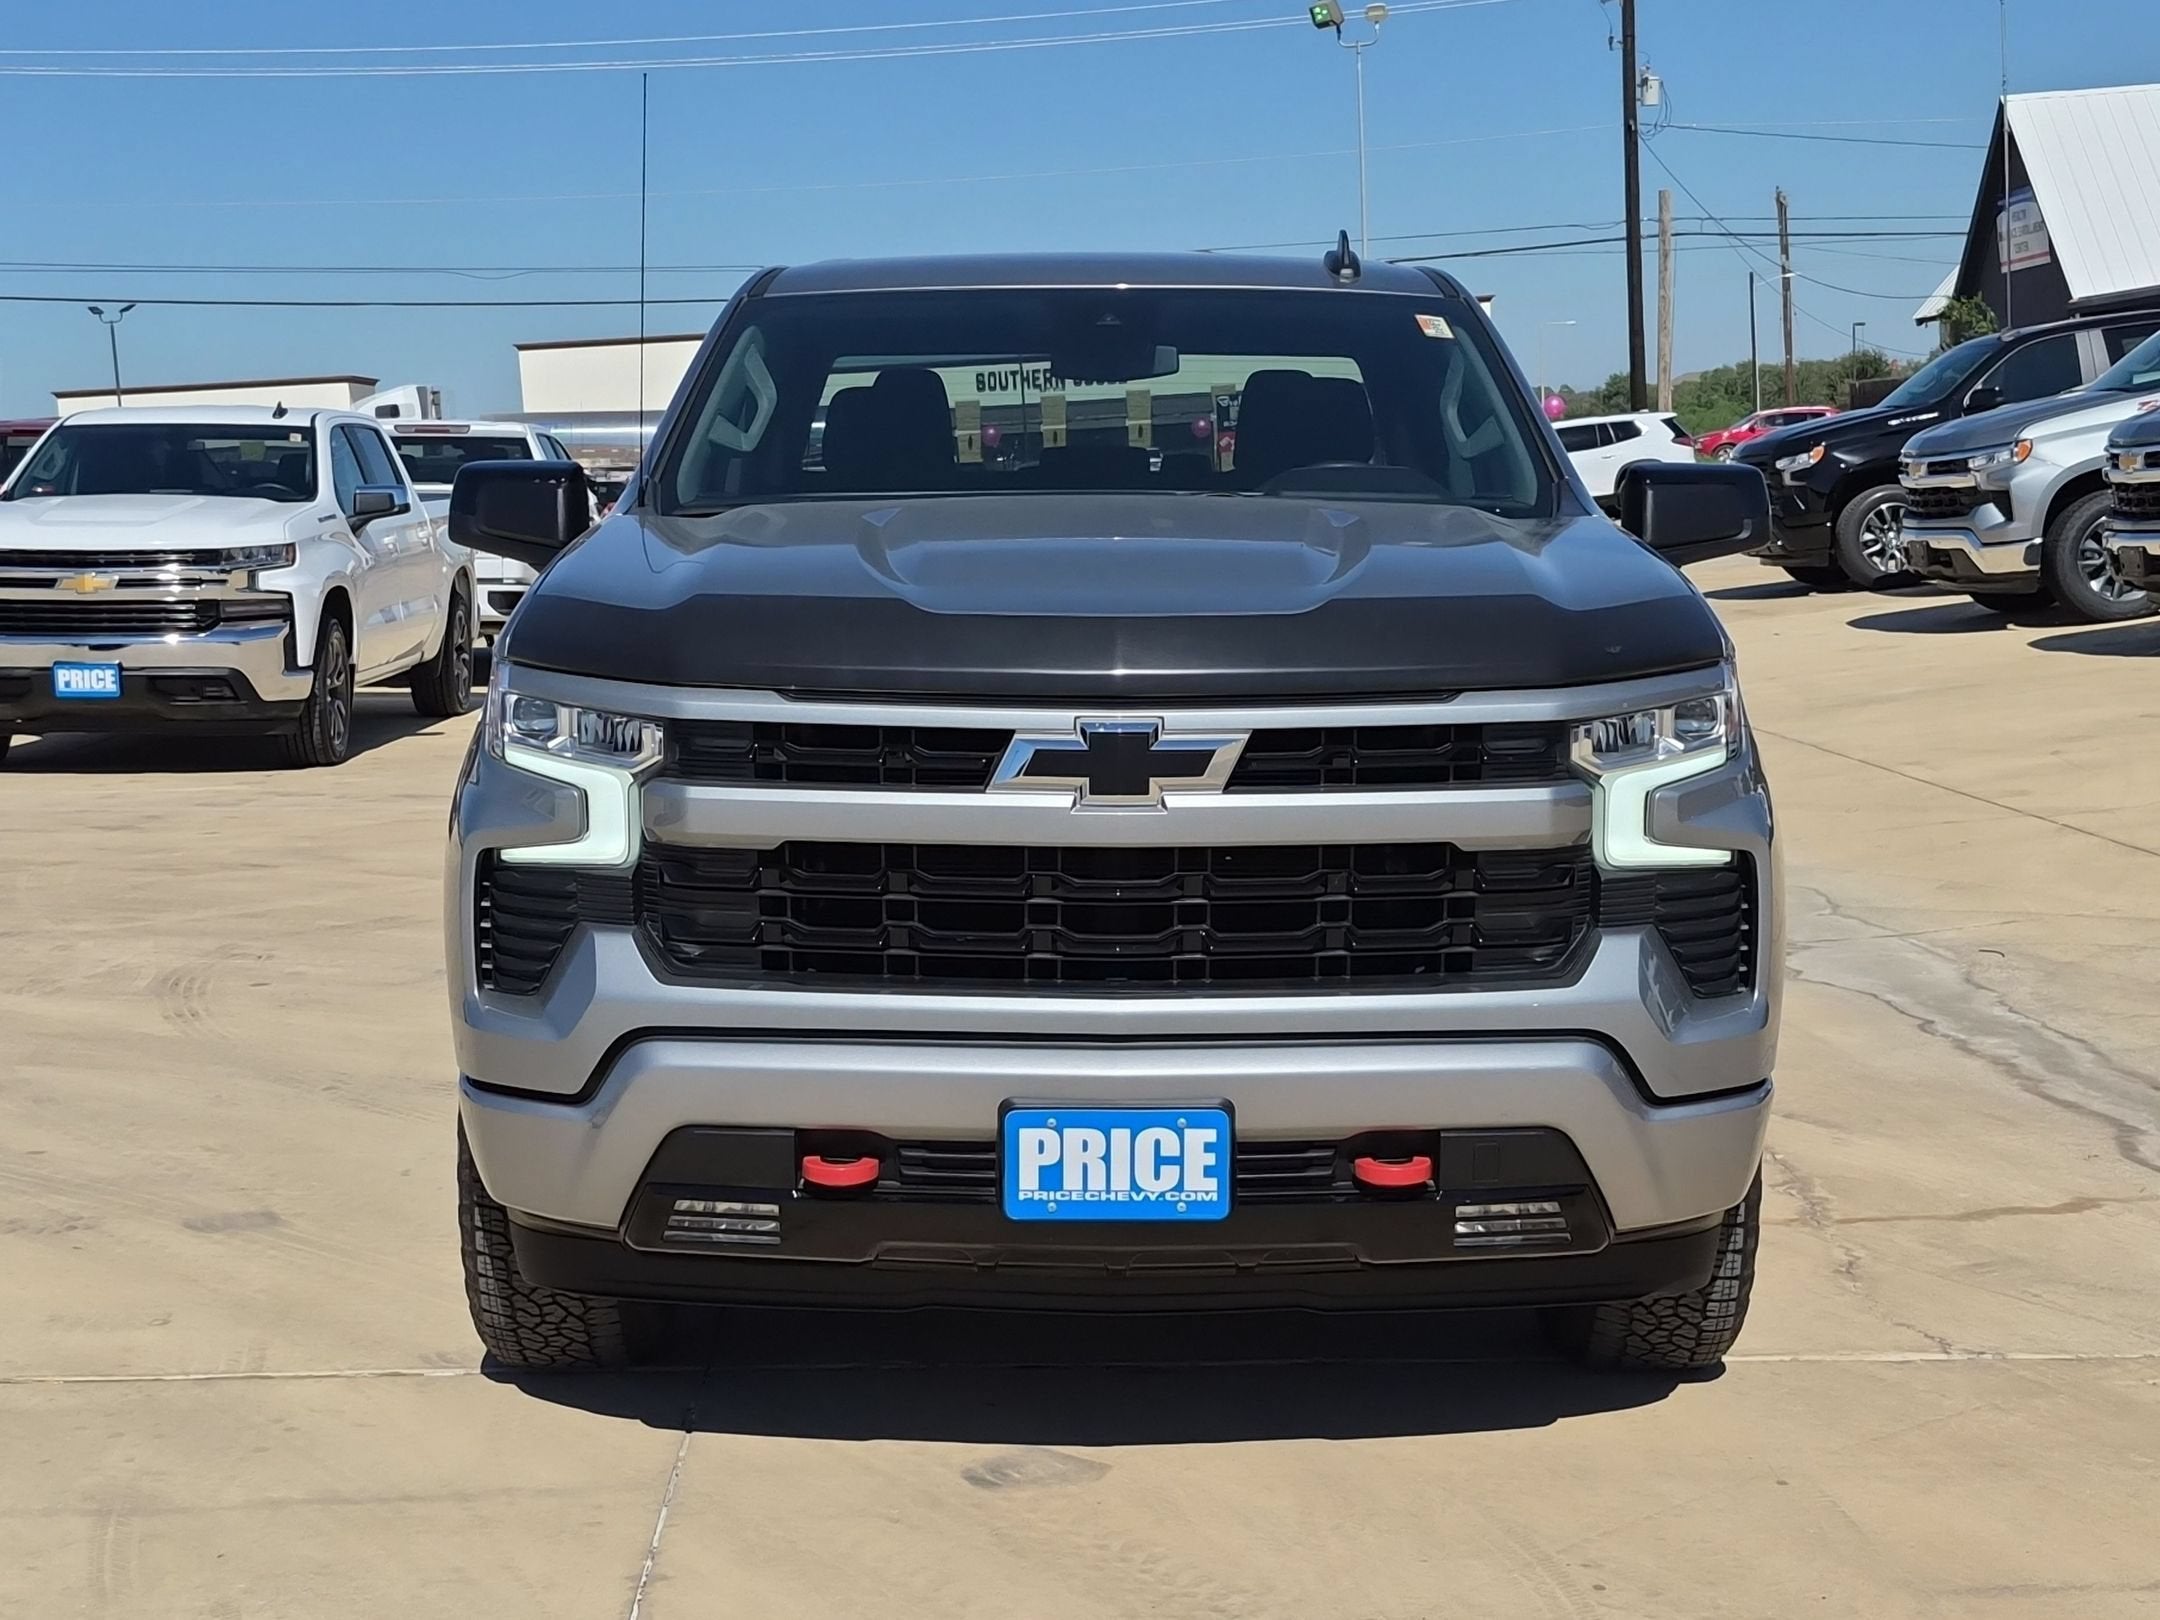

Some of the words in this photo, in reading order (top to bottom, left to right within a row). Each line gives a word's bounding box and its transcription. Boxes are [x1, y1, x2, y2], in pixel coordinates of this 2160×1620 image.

[57, 668, 117, 689] PRICE
[1018, 1127, 1218, 1192] PRICE
[1018, 1190, 1218, 1202] PRICECHEVY.COM
